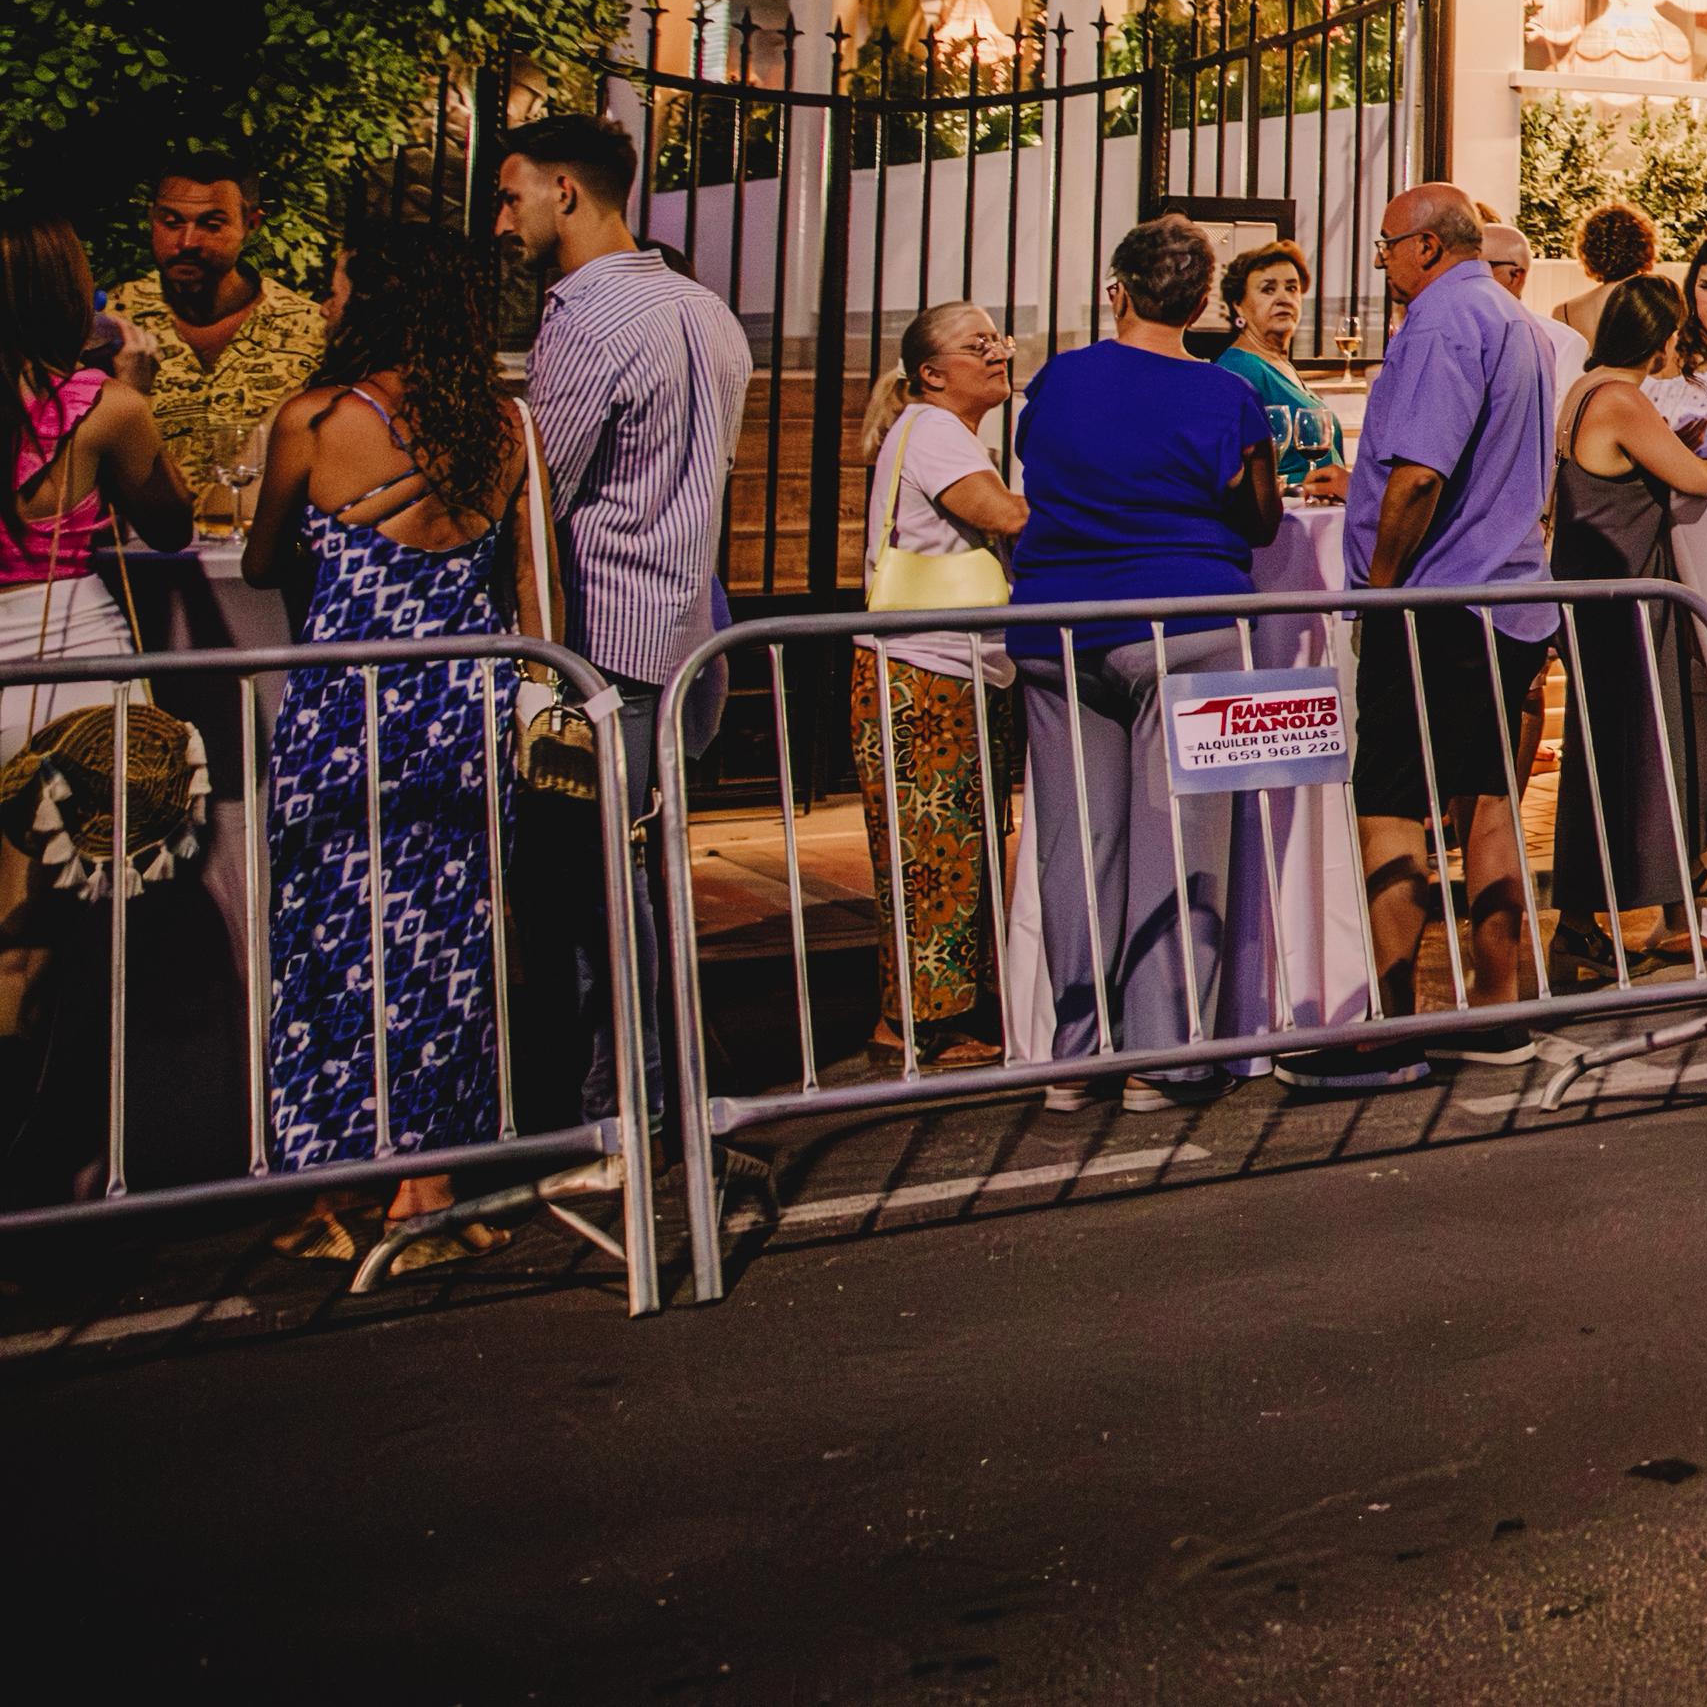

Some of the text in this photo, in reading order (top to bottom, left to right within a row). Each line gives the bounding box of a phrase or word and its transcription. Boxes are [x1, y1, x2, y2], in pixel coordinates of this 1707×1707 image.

[1231, 713, 1338, 735] MANOLO
[1197, 729, 1328, 751] ALQUILER DE VALLAS
[1228, 749, 1261, 762] 659
[1268, 745, 1301, 758] 968
[1308, 740, 1340, 754] 220
